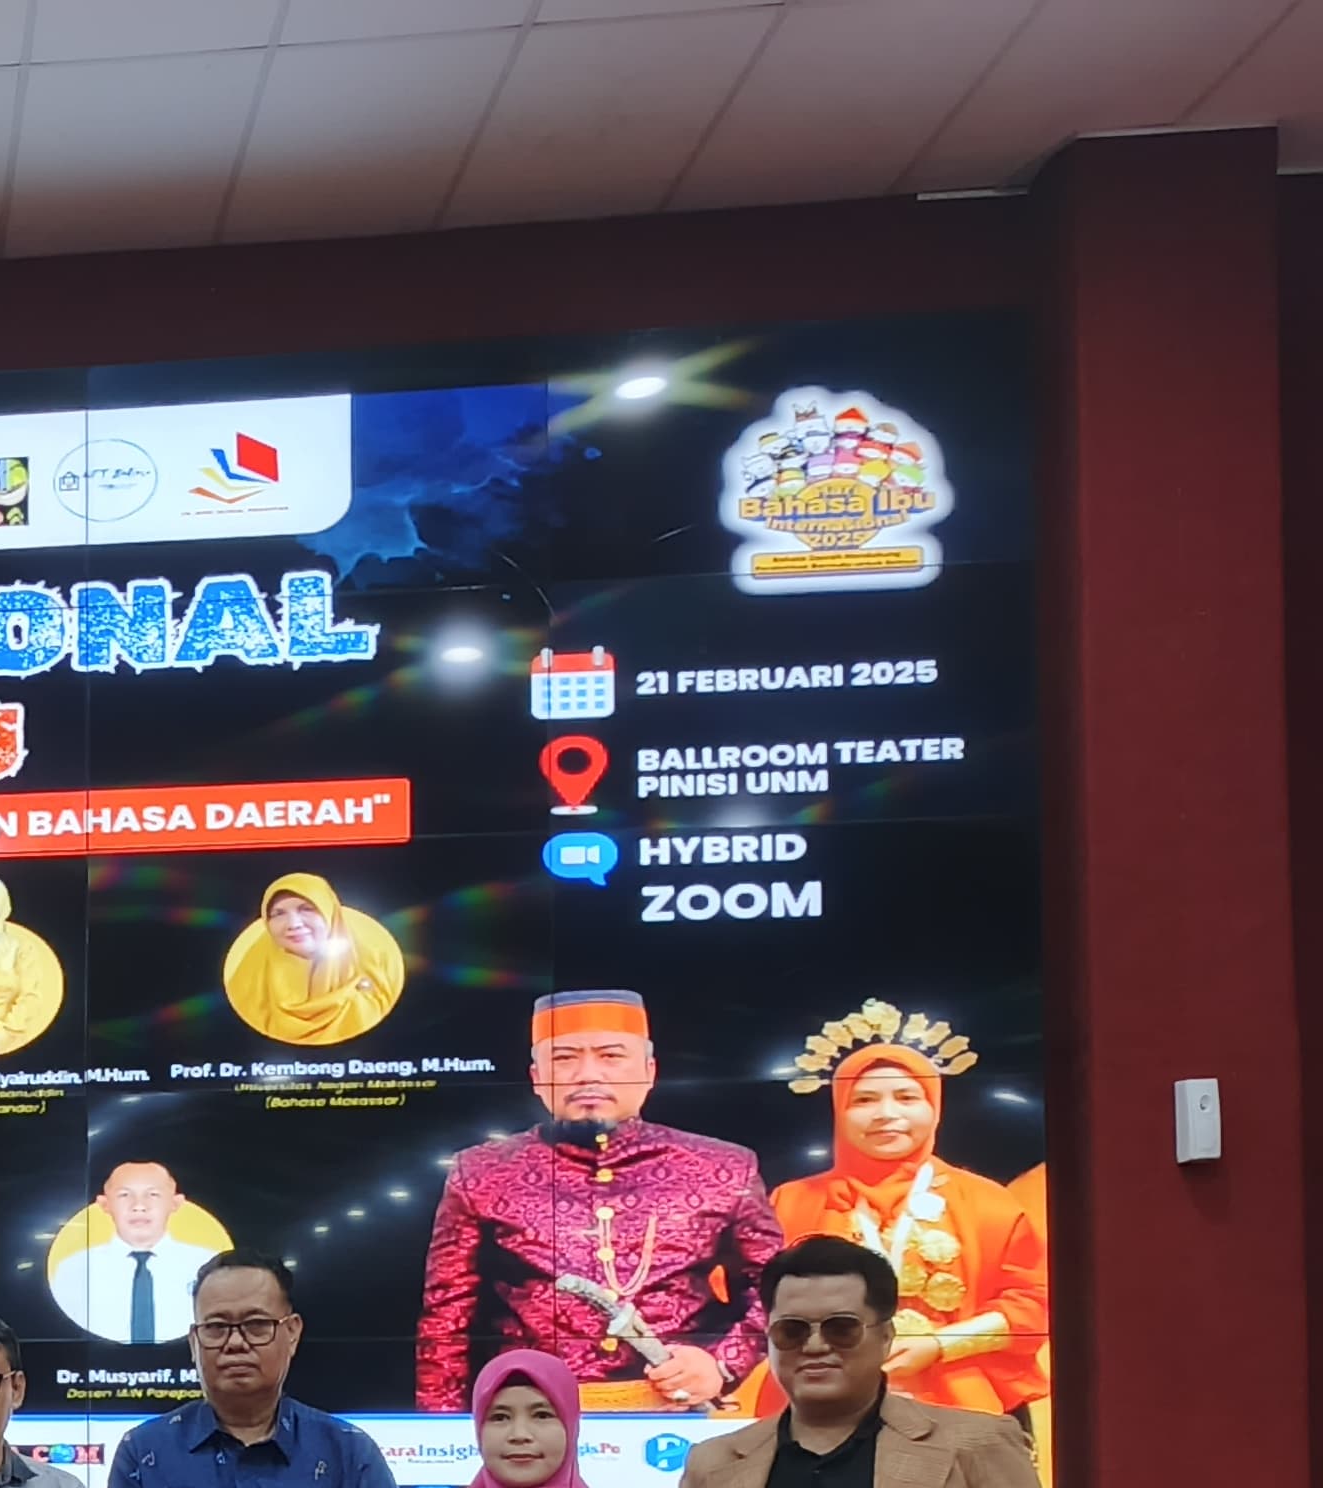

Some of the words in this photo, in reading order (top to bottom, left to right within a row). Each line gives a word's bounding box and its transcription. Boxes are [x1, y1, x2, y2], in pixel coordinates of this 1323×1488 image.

[739, 497, 866, 520] Bahasa
[877, 489, 935, 512] Ibu
[809, 531, 866, 547] 2025
[636, 671, 669, 695] 21
[677, 664, 844, 694] FEBRUARI
[850, 660, 938, 687] 2025
[637, 743, 828, 772] BALLROOM
[833, 737, 964, 764] TEATER
[637, 771, 738, 798] PINISI
[746, 769, 829, 795] UNM
[35, 804, 195, 838] BAHASA
[206, 793, 392, 829] DAERAH"
[639, 833, 808, 866] HYBRID
[641, 880, 822, 923] ZOOM
[86, 1069, 150, 1082] M.Hum.
[171, 1064, 215, 1077] Prof.
[219, 1063, 246, 1077] Dr.
[251, 1061, 345, 1077] Kembong
[348, 1059, 418, 1076] Daeng,
[422, 1058, 495, 1072] M.Hum.
[56, 1370, 84, 1384] Dr.
[89, 1369, 175, 1386] Musyarif,
